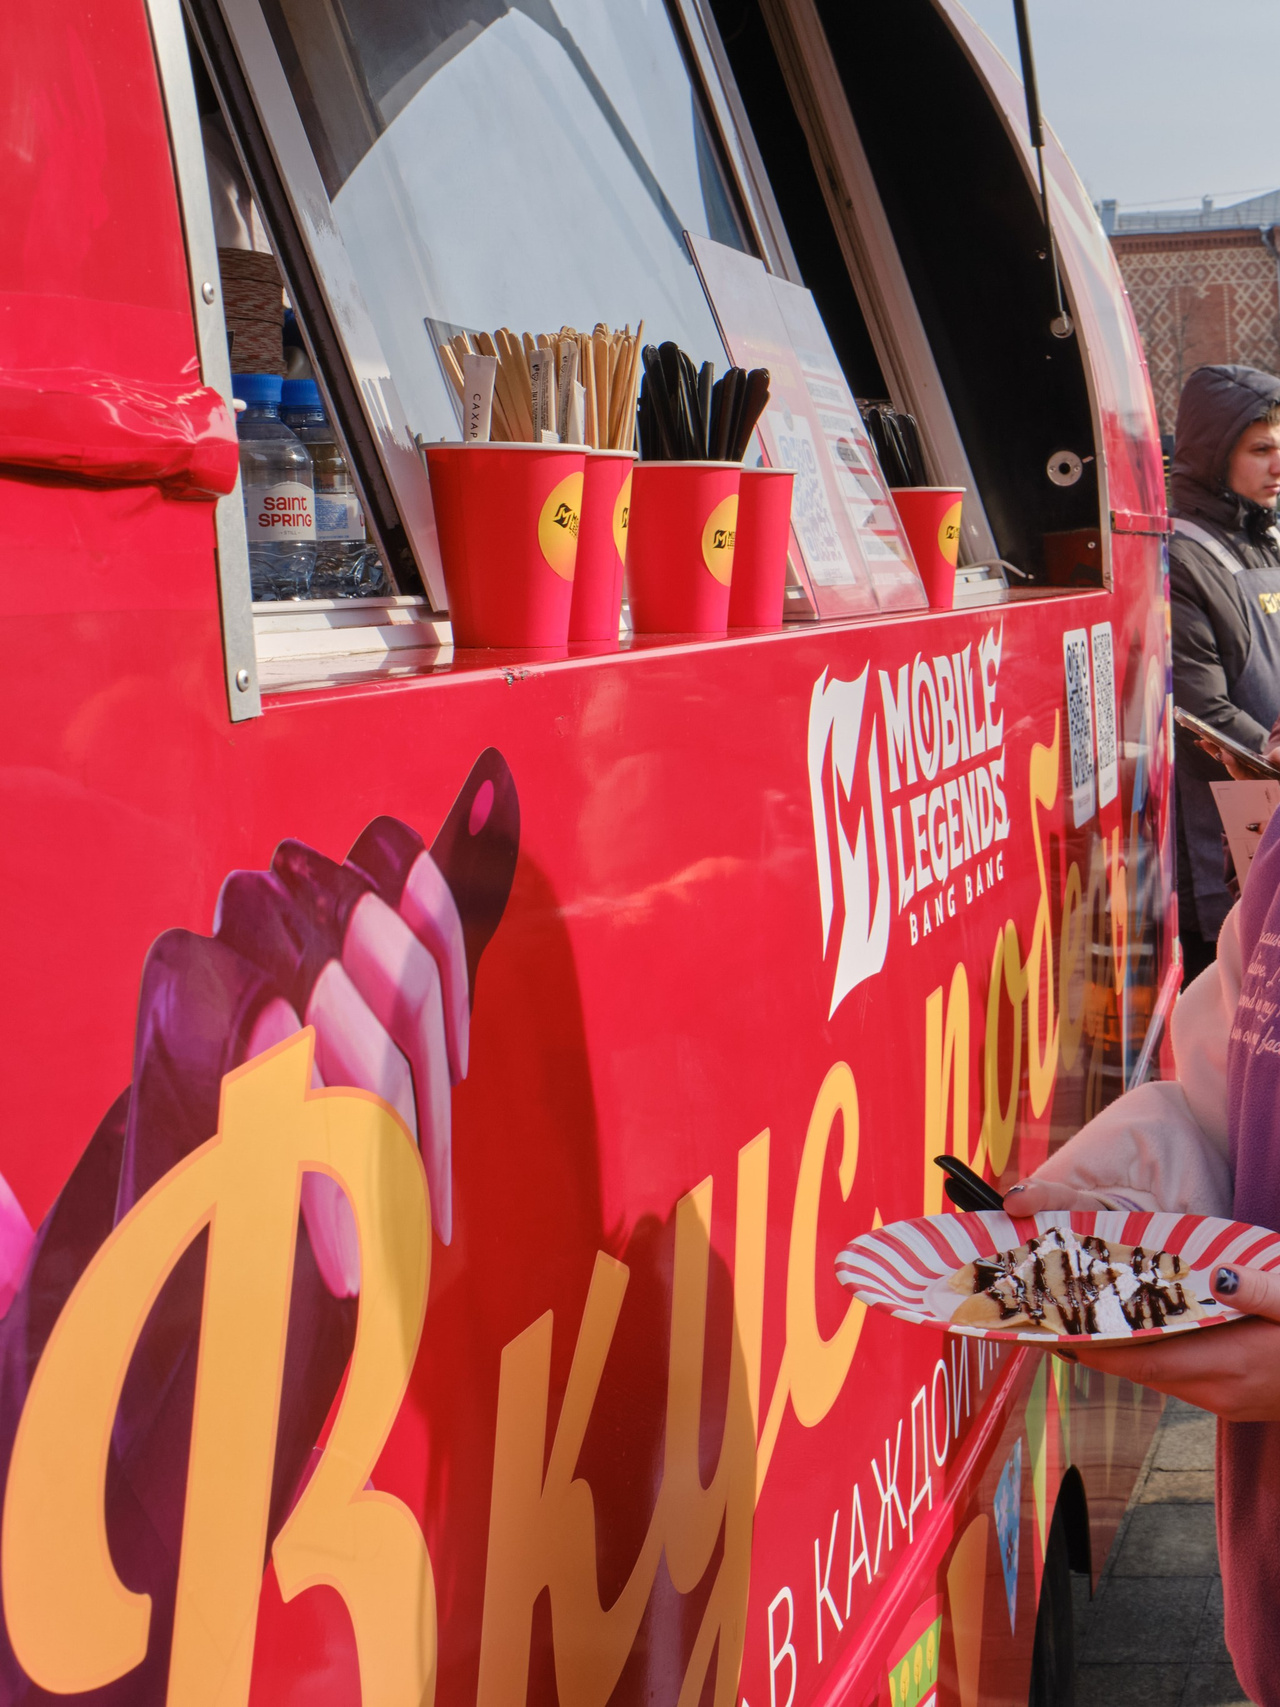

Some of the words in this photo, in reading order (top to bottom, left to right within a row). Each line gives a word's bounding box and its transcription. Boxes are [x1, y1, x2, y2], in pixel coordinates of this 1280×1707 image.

[470, 393, 482, 438] САХАР
[258, 513, 312, 528] SPRING
[263, 496, 307, 511] saint
[878, 614, 1004, 793] MOBILE
[891, 744, 1010, 916] LEGENDS
[910, 881, 956, 946] BANG
[966, 851, 1005, 906] BANG
[2, 1023, 880, 1707] Вкус
[767, 1586, 798, 1707] В
